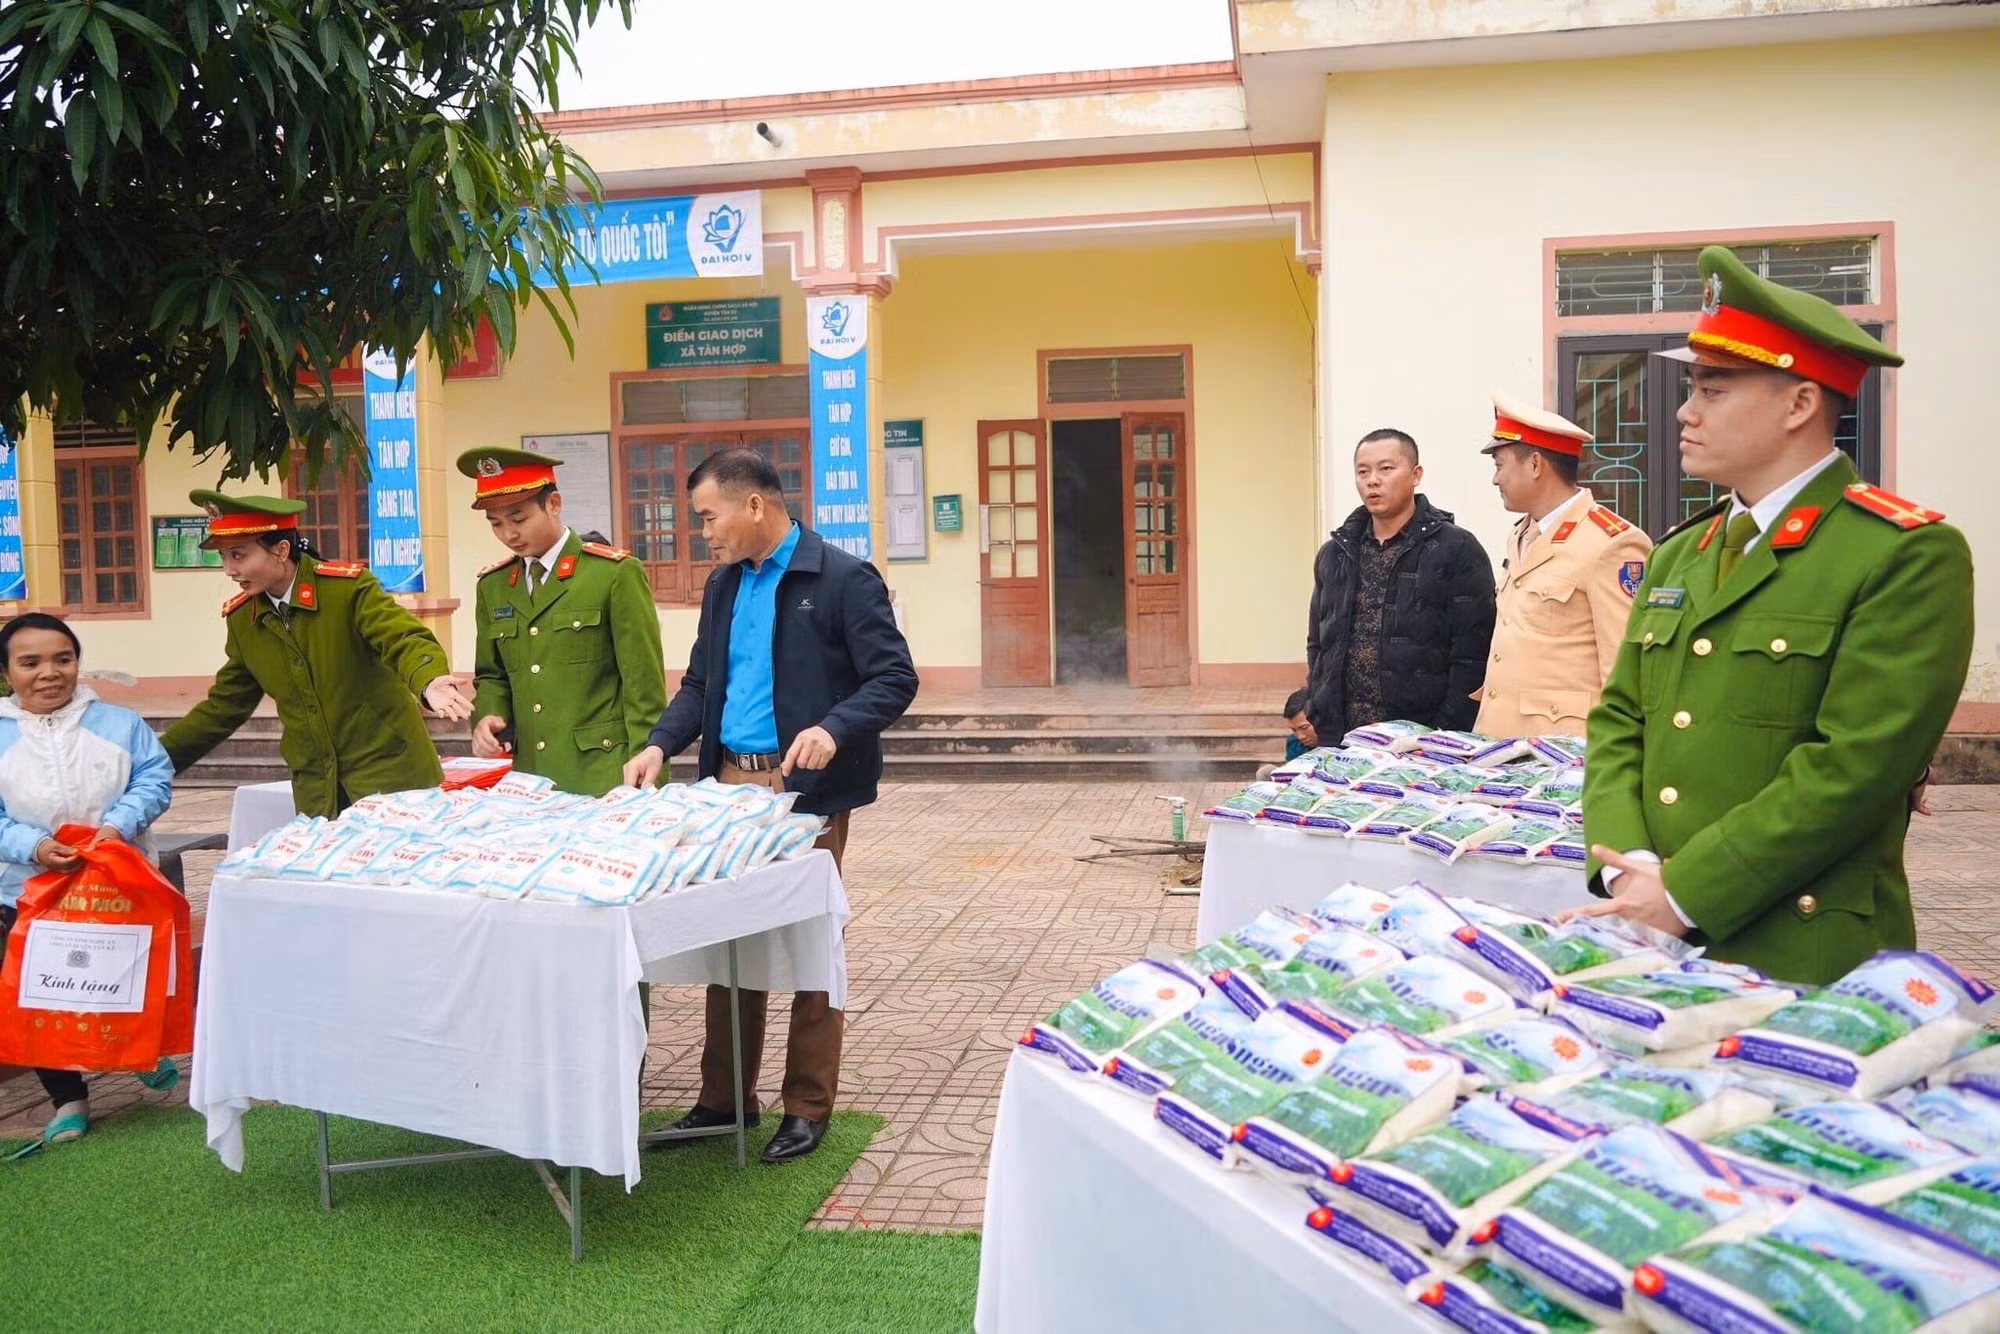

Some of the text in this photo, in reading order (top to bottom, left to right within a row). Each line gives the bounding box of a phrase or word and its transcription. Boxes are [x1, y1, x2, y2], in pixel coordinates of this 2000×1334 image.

[601, 209, 641, 266] QUỐC
[744, 253, 752, 261] V
[663, 328, 763, 343] ĐIỂM GIAO DỊCH
[681, 343, 747, 357] XÃ TÂN HỢP
[370, 391, 396, 420] THANH
[378, 434, 410, 475] TÂN HỢP
[377, 483, 397, 518] SÁNG
[393, 532, 420, 572] NGHIỆP
[38, 974, 120, 995] Kính tặng
[1182, 1010, 1228, 1047] Suga
[1227, 1037, 1295, 1085] Sugar
[1325, 1062, 1401, 1097] ugar
